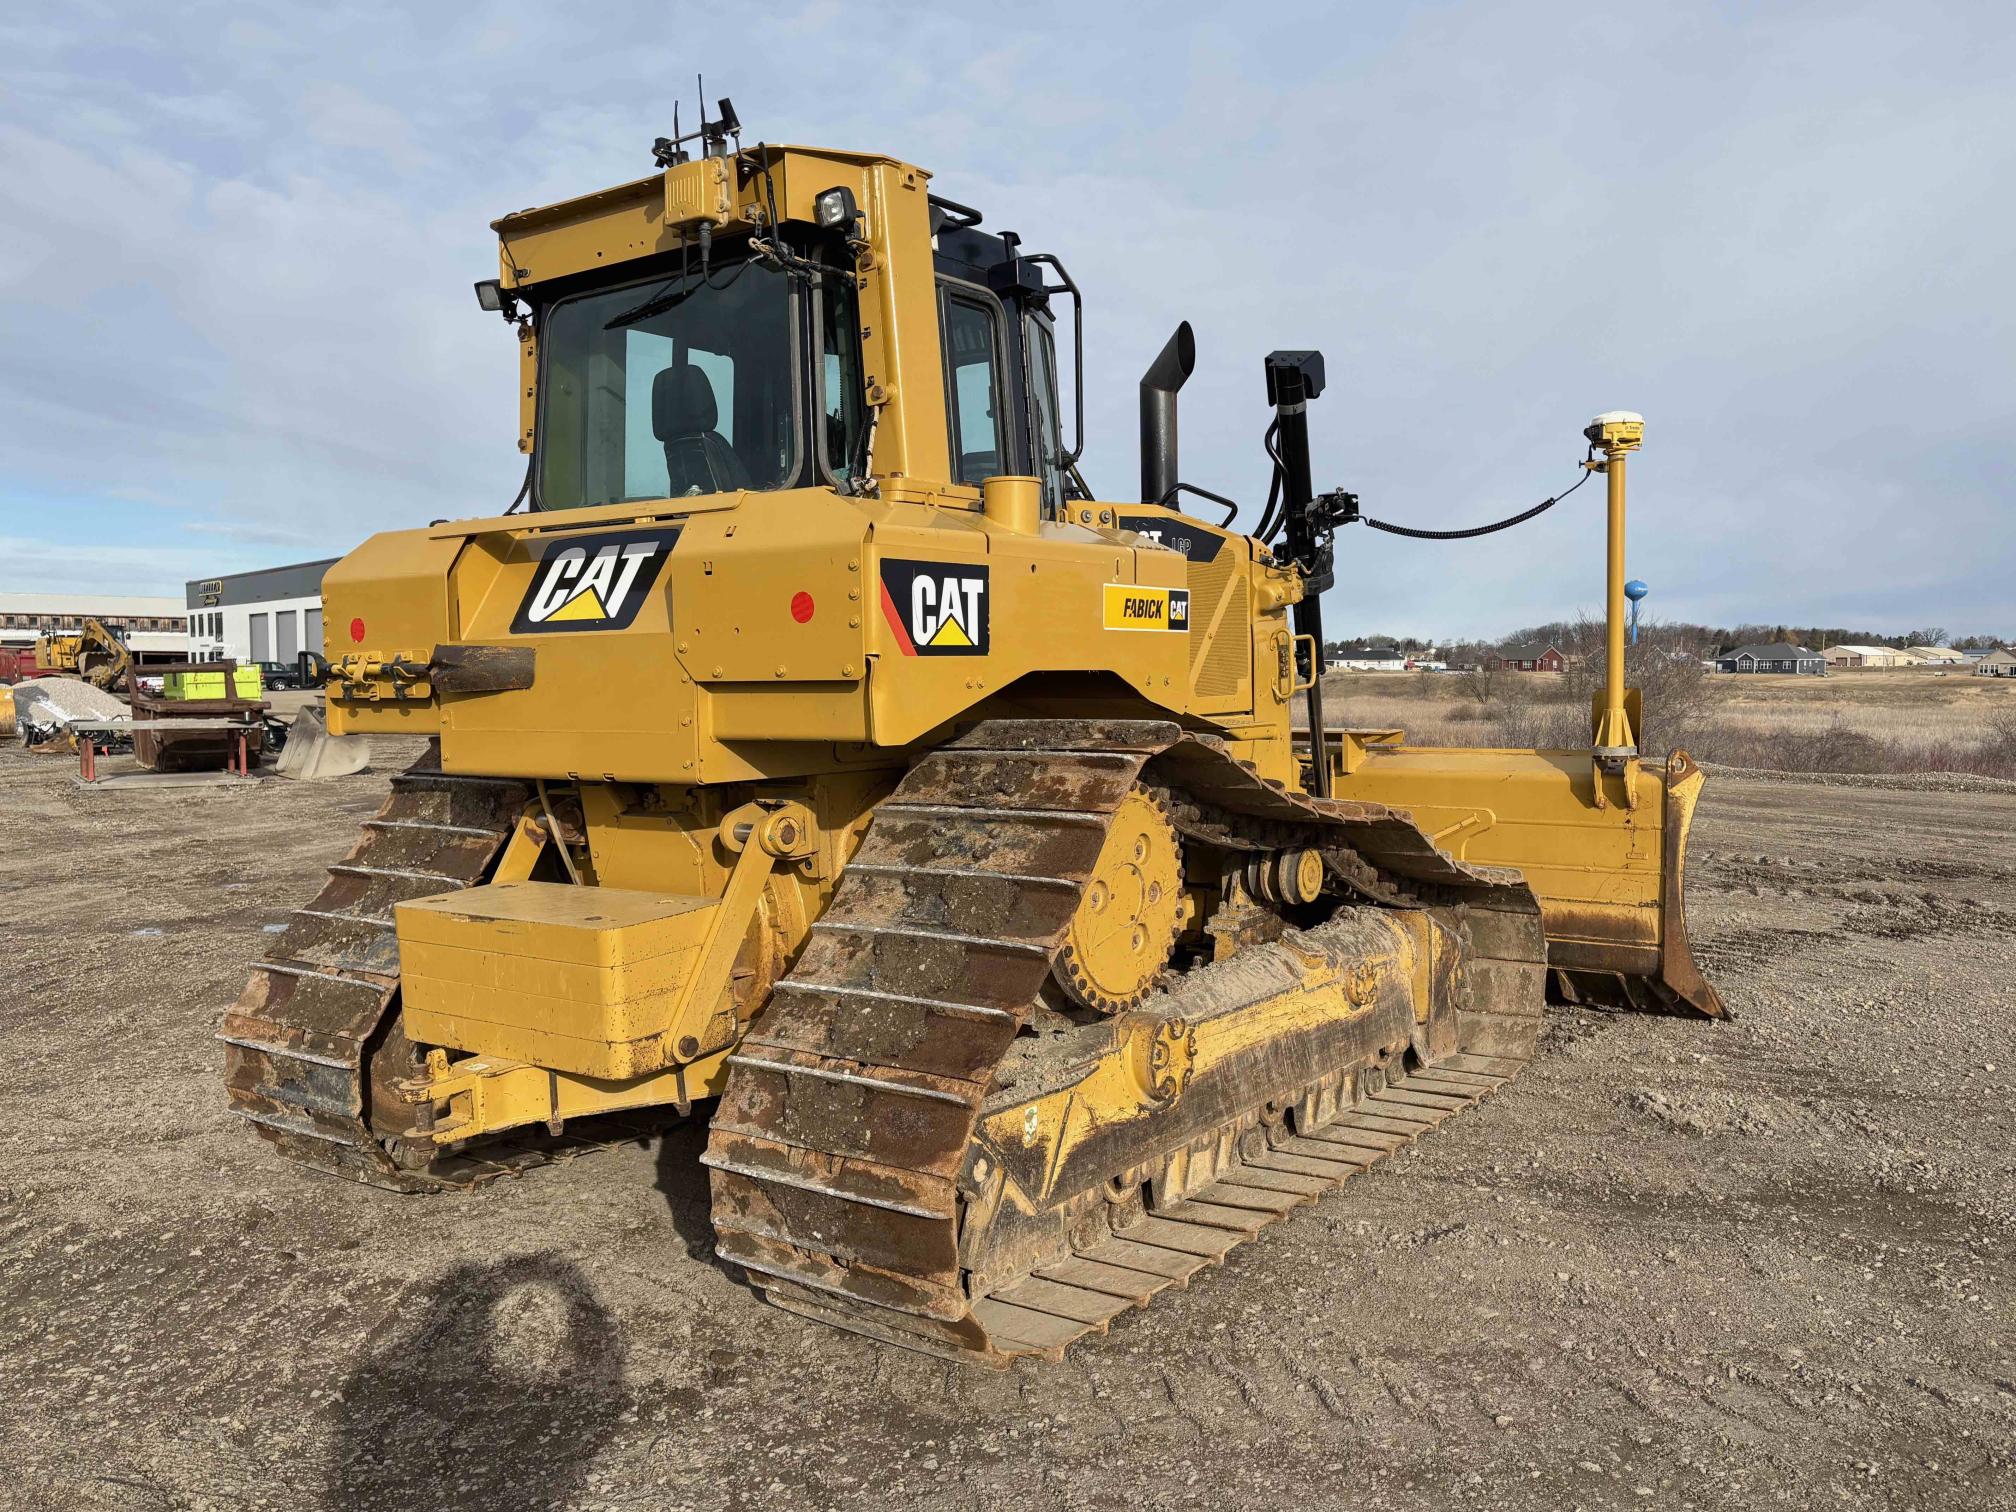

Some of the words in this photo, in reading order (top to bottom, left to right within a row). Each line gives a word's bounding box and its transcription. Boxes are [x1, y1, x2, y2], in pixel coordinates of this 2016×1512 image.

[528, 541, 660, 622] CAT
[911, 574, 984, 646] CAT
[1123, 597, 1164, 619] FABICK
[1170, 600, 1187, 621] CAT
